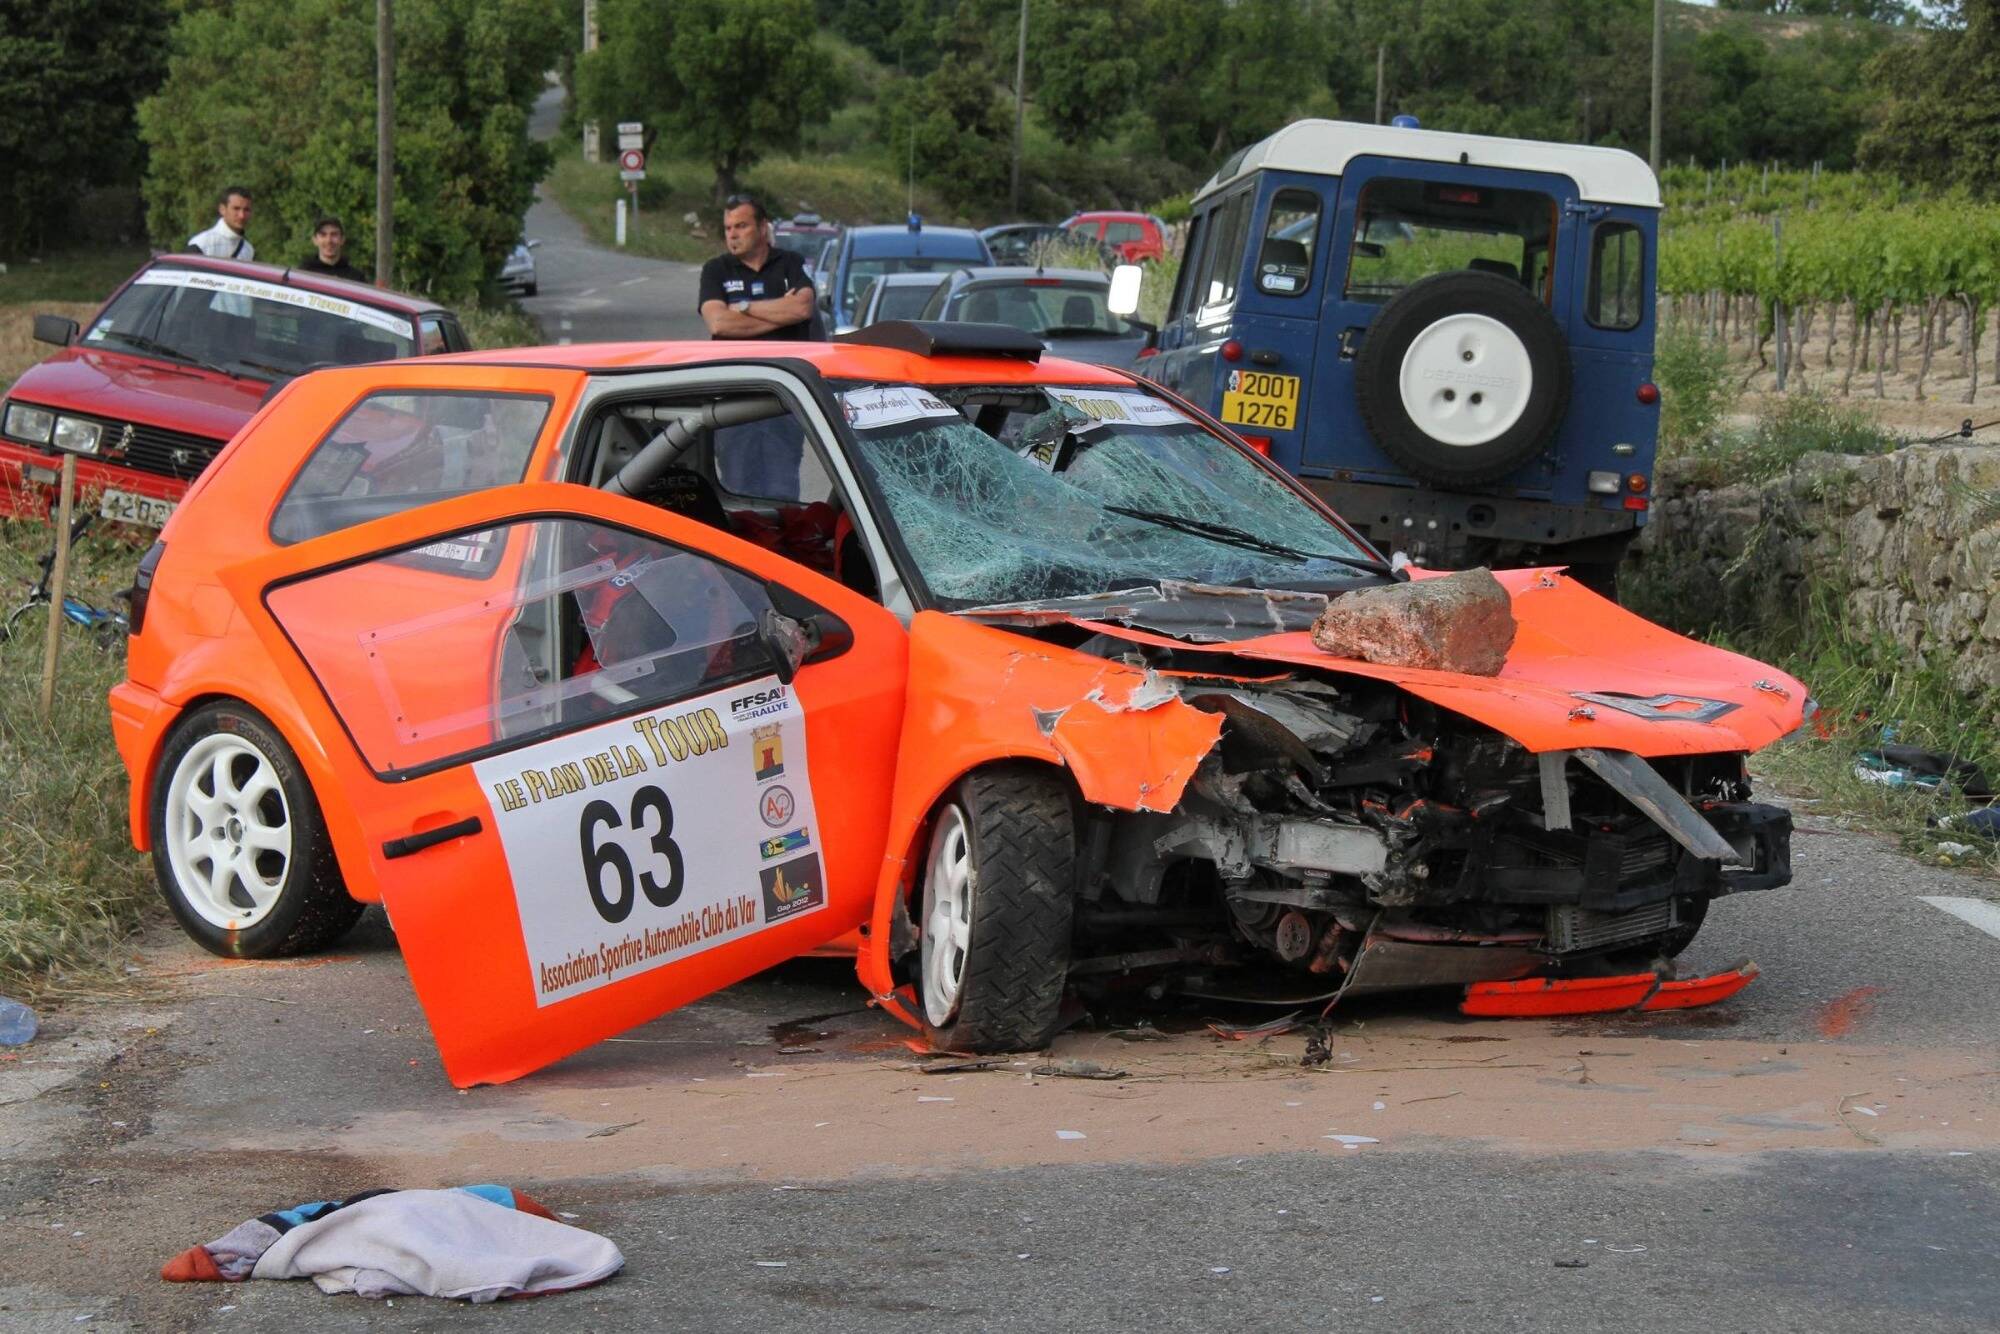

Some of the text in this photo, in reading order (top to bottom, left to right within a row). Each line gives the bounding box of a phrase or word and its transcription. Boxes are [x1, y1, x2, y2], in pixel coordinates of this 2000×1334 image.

[1243, 373, 1296, 399] 2001
[1237, 401, 1288, 427] 1276
[731, 687, 782, 712] FFSA
[752, 701, 789, 718] RALLYE
[494, 707, 728, 812] LE PLAN DE LA TOUR
[580, 785, 685, 924] 63
[777, 903, 791, 912] Gap
[792, 896, 809, 907] 2012
[540, 948, 600, 994] Association
[600, 933, 643, 980] Sportive
[644, 911, 701, 959] Automobile
[702, 902, 724, 938] Club
[725, 898, 738, 930] du
[738, 894, 756, 926] Var
